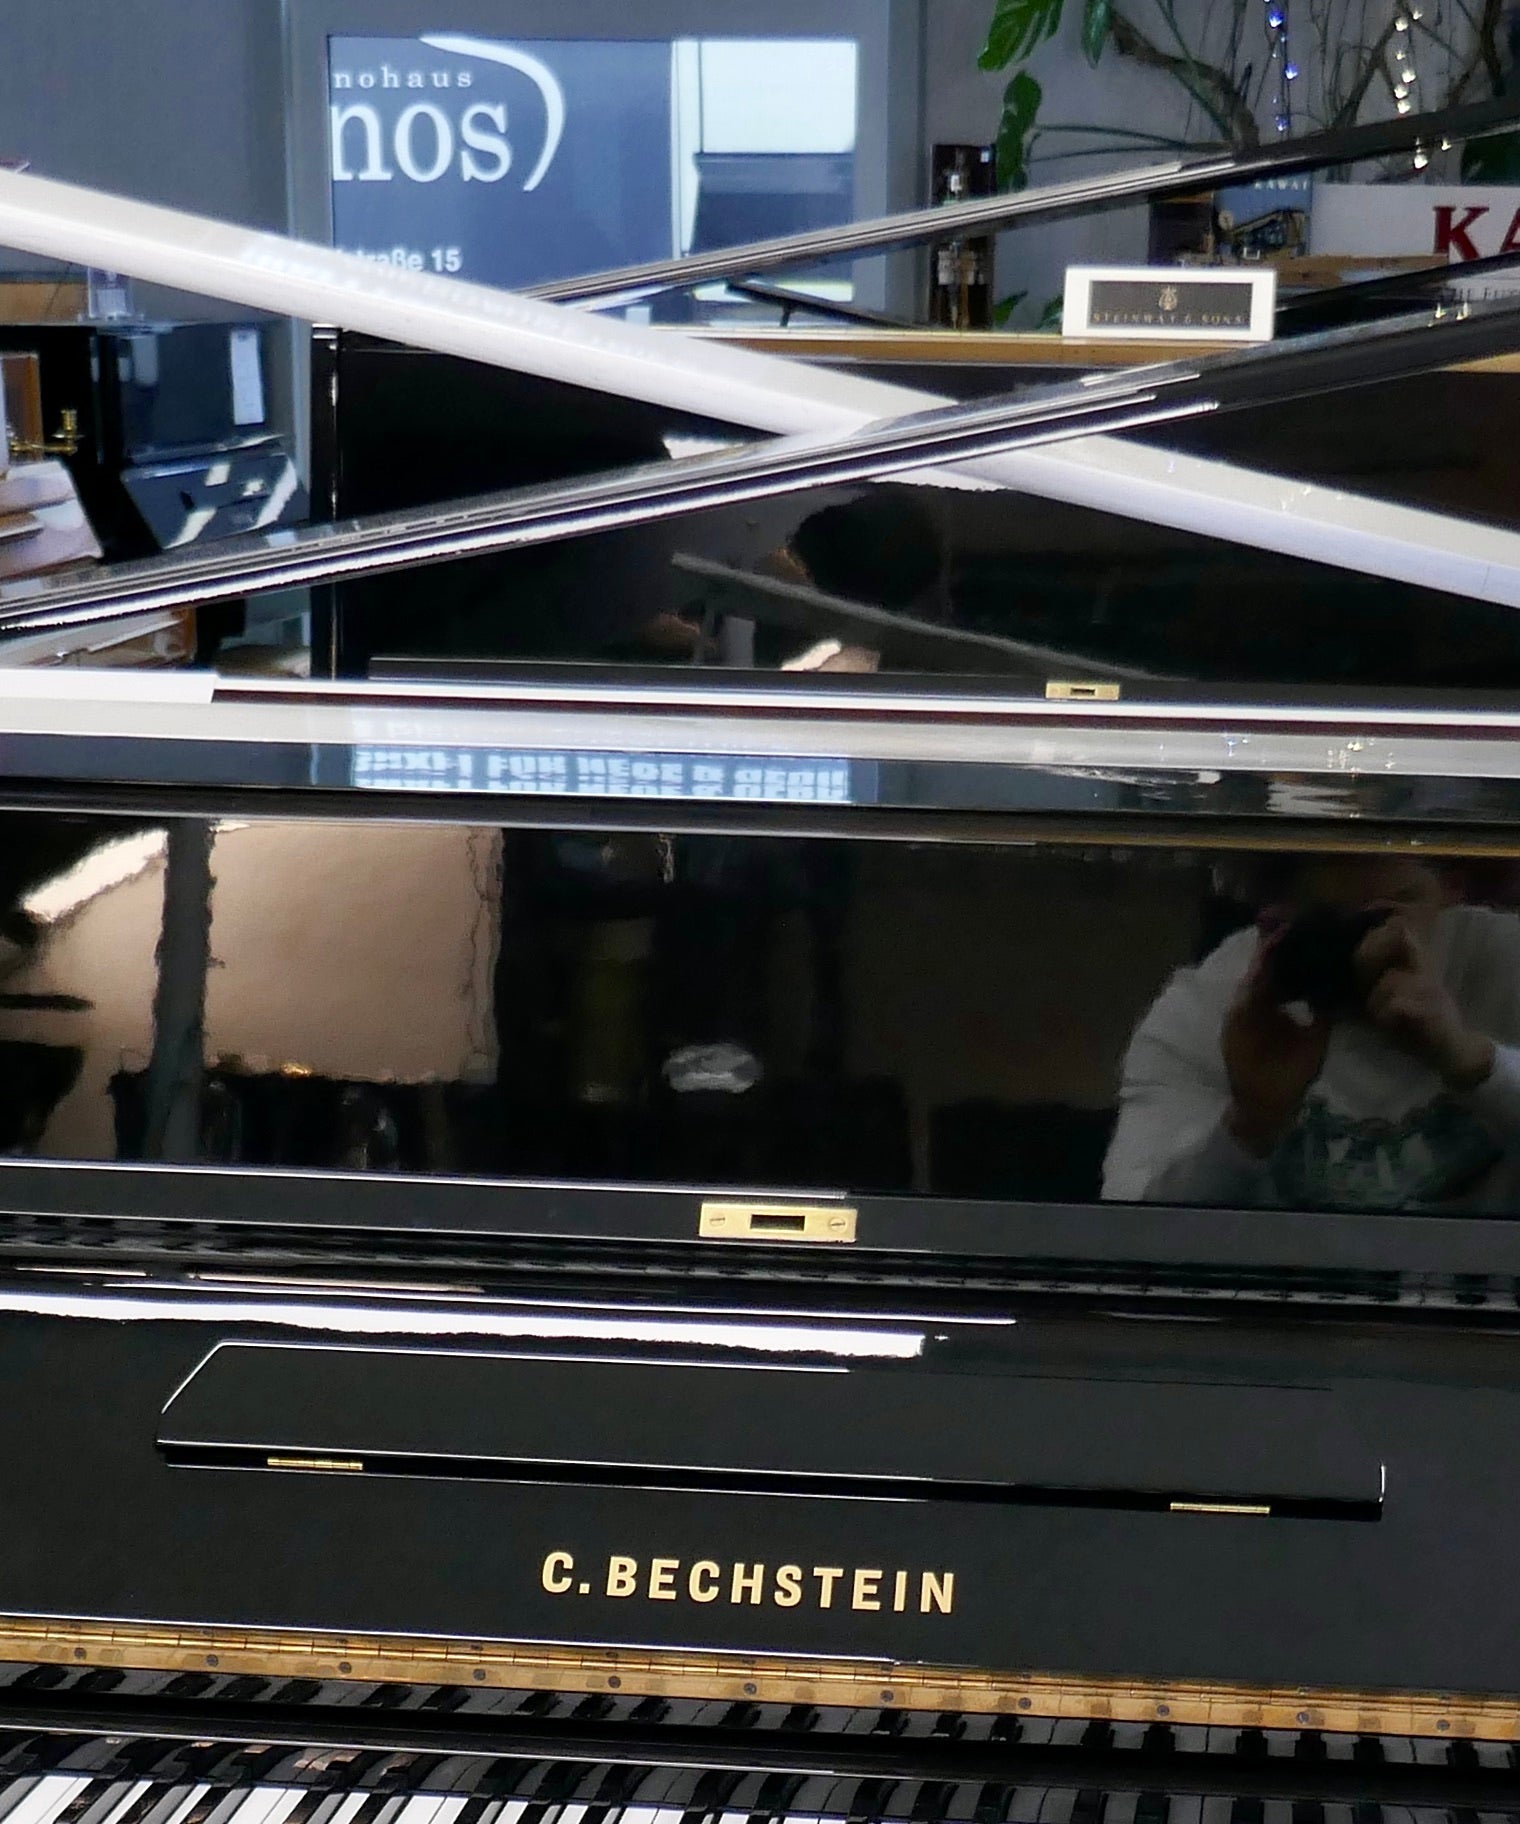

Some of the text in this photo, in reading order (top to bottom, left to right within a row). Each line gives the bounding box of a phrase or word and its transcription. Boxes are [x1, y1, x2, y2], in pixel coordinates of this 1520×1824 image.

[334, 66, 473, 89] nohaus
[431, 248, 462, 272] 15
[541, 1551, 956, 1614] C. BECHSTEIN
